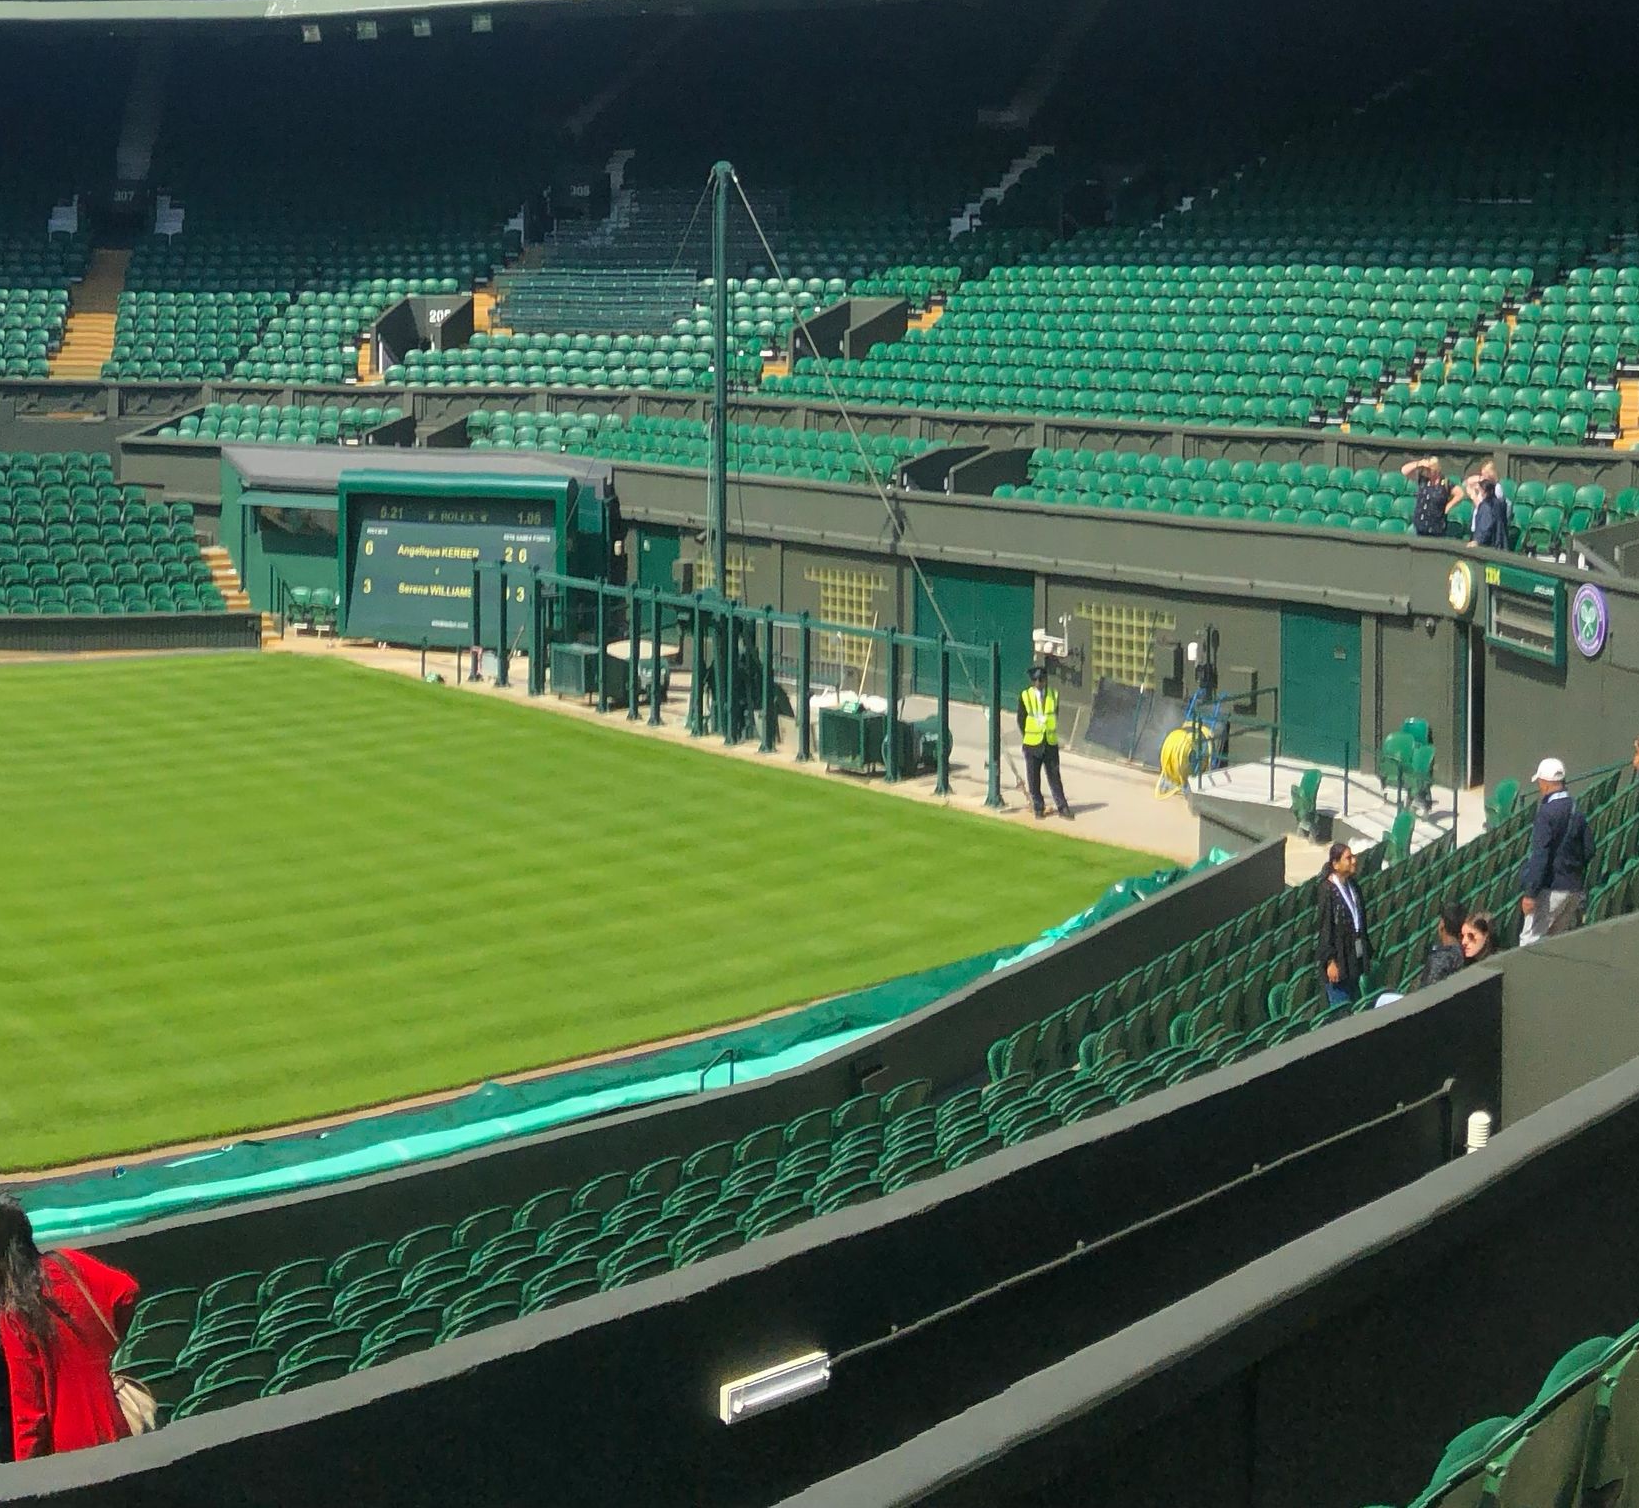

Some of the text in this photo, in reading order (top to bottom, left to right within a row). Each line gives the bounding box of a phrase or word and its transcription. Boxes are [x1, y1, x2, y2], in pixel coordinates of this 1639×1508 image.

[397, 544, 440, 559] Angelique
[441, 546, 479, 559] KERBER
[505, 547, 513, 562] 2
[1485, 567, 1500, 586] IBM
[363, 578, 372, 593] 3
[398, 582, 429, 595] Serena
[516, 586, 525, 602] 3
